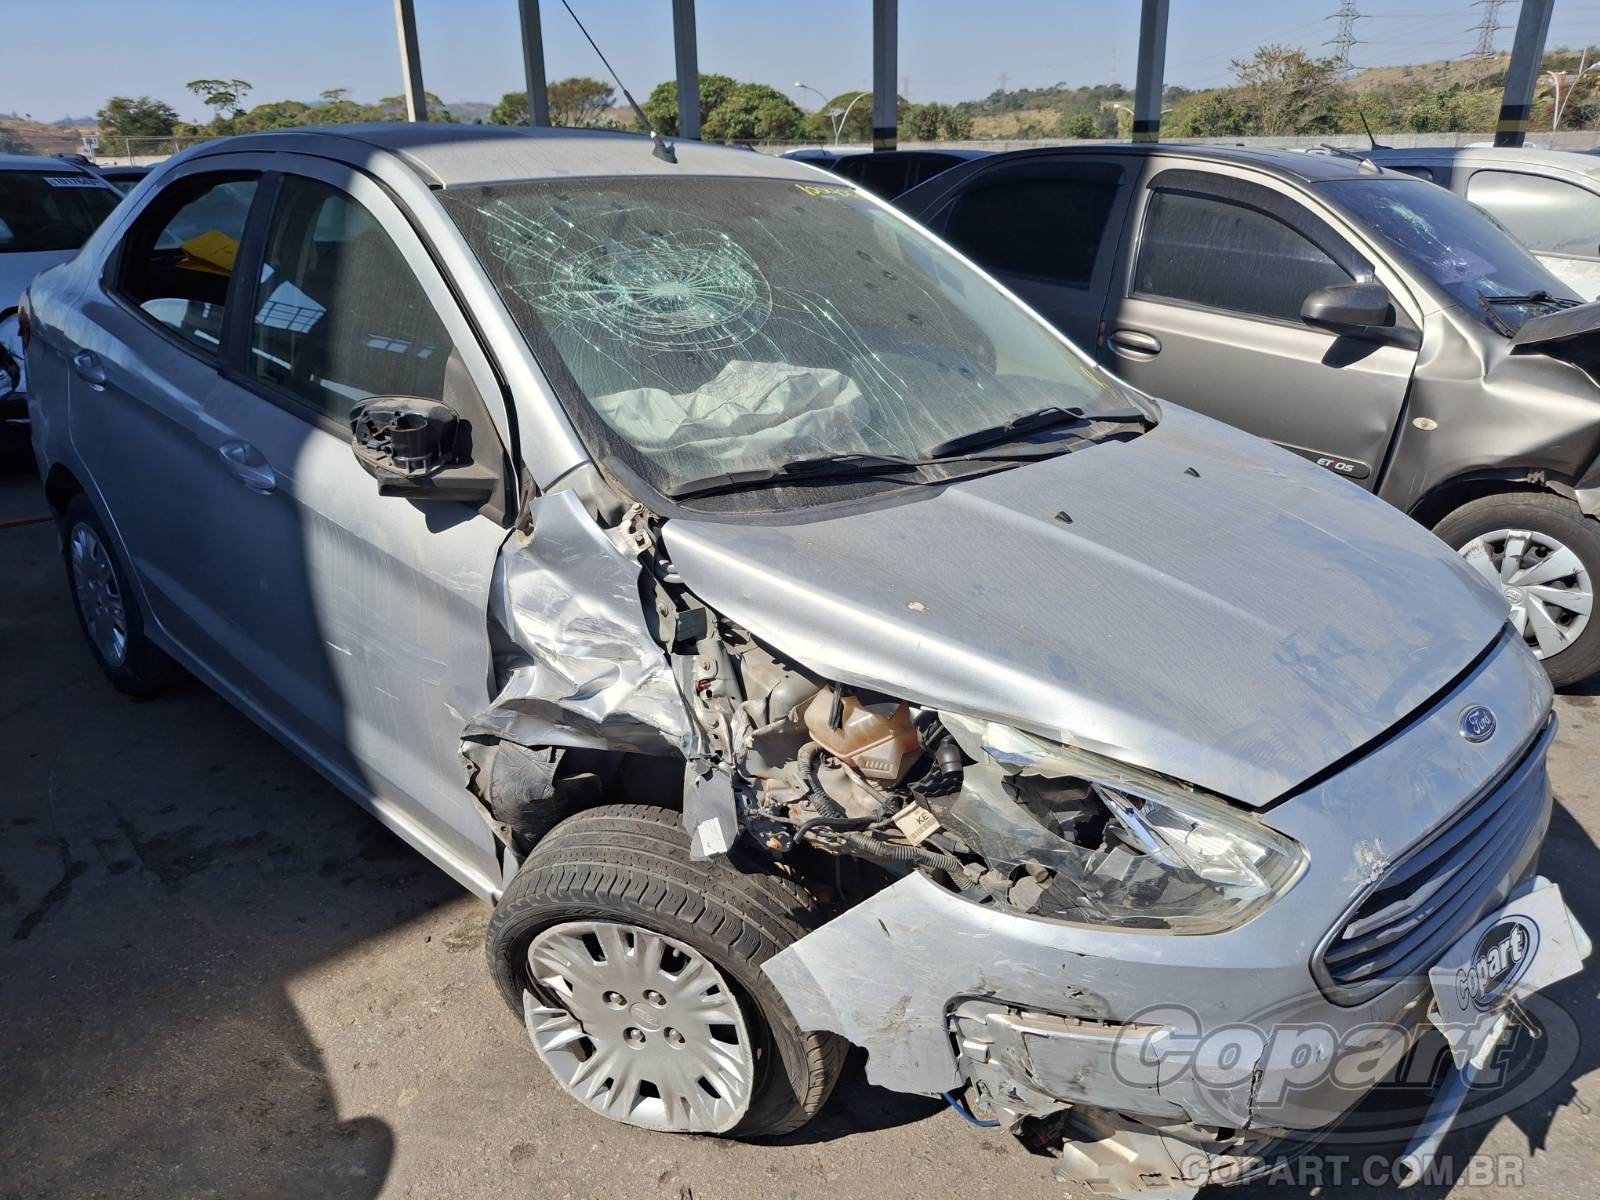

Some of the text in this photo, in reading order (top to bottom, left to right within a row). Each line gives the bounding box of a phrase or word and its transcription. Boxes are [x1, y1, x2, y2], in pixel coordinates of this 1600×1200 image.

[1468, 711, 1491, 734] Ford
[916, 812, 929, 825] KE
[1455, 922, 1525, 1012] Copart
